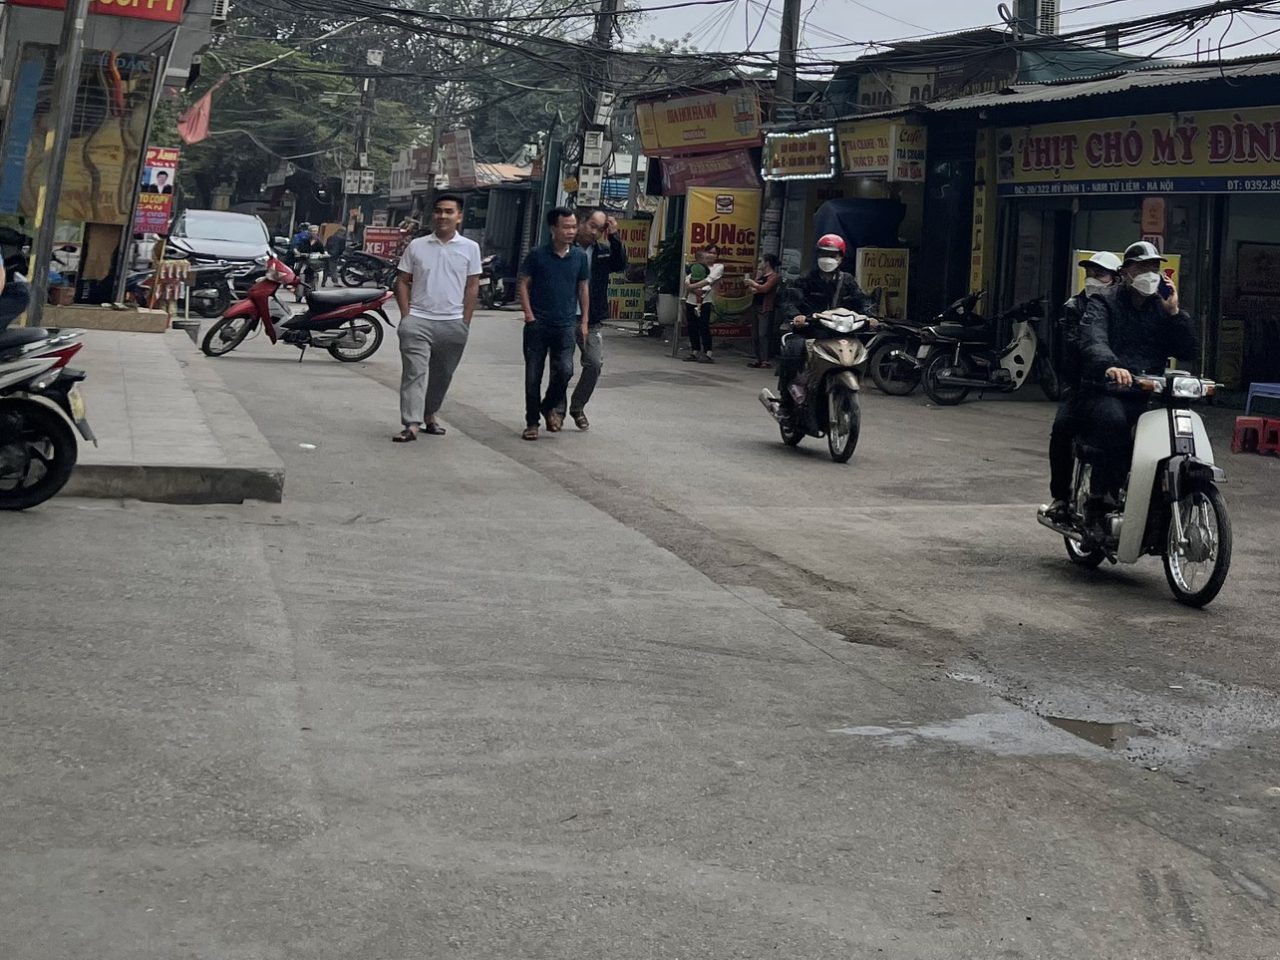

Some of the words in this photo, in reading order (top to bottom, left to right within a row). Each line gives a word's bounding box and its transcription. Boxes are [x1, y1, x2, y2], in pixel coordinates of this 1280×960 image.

[1018, 133, 1079, 177] THỊT
[1085, 121, 1144, 168] CHÓ
[1151, 116, 1200, 165] MỸ
[691, 216, 734, 245] BÚN
